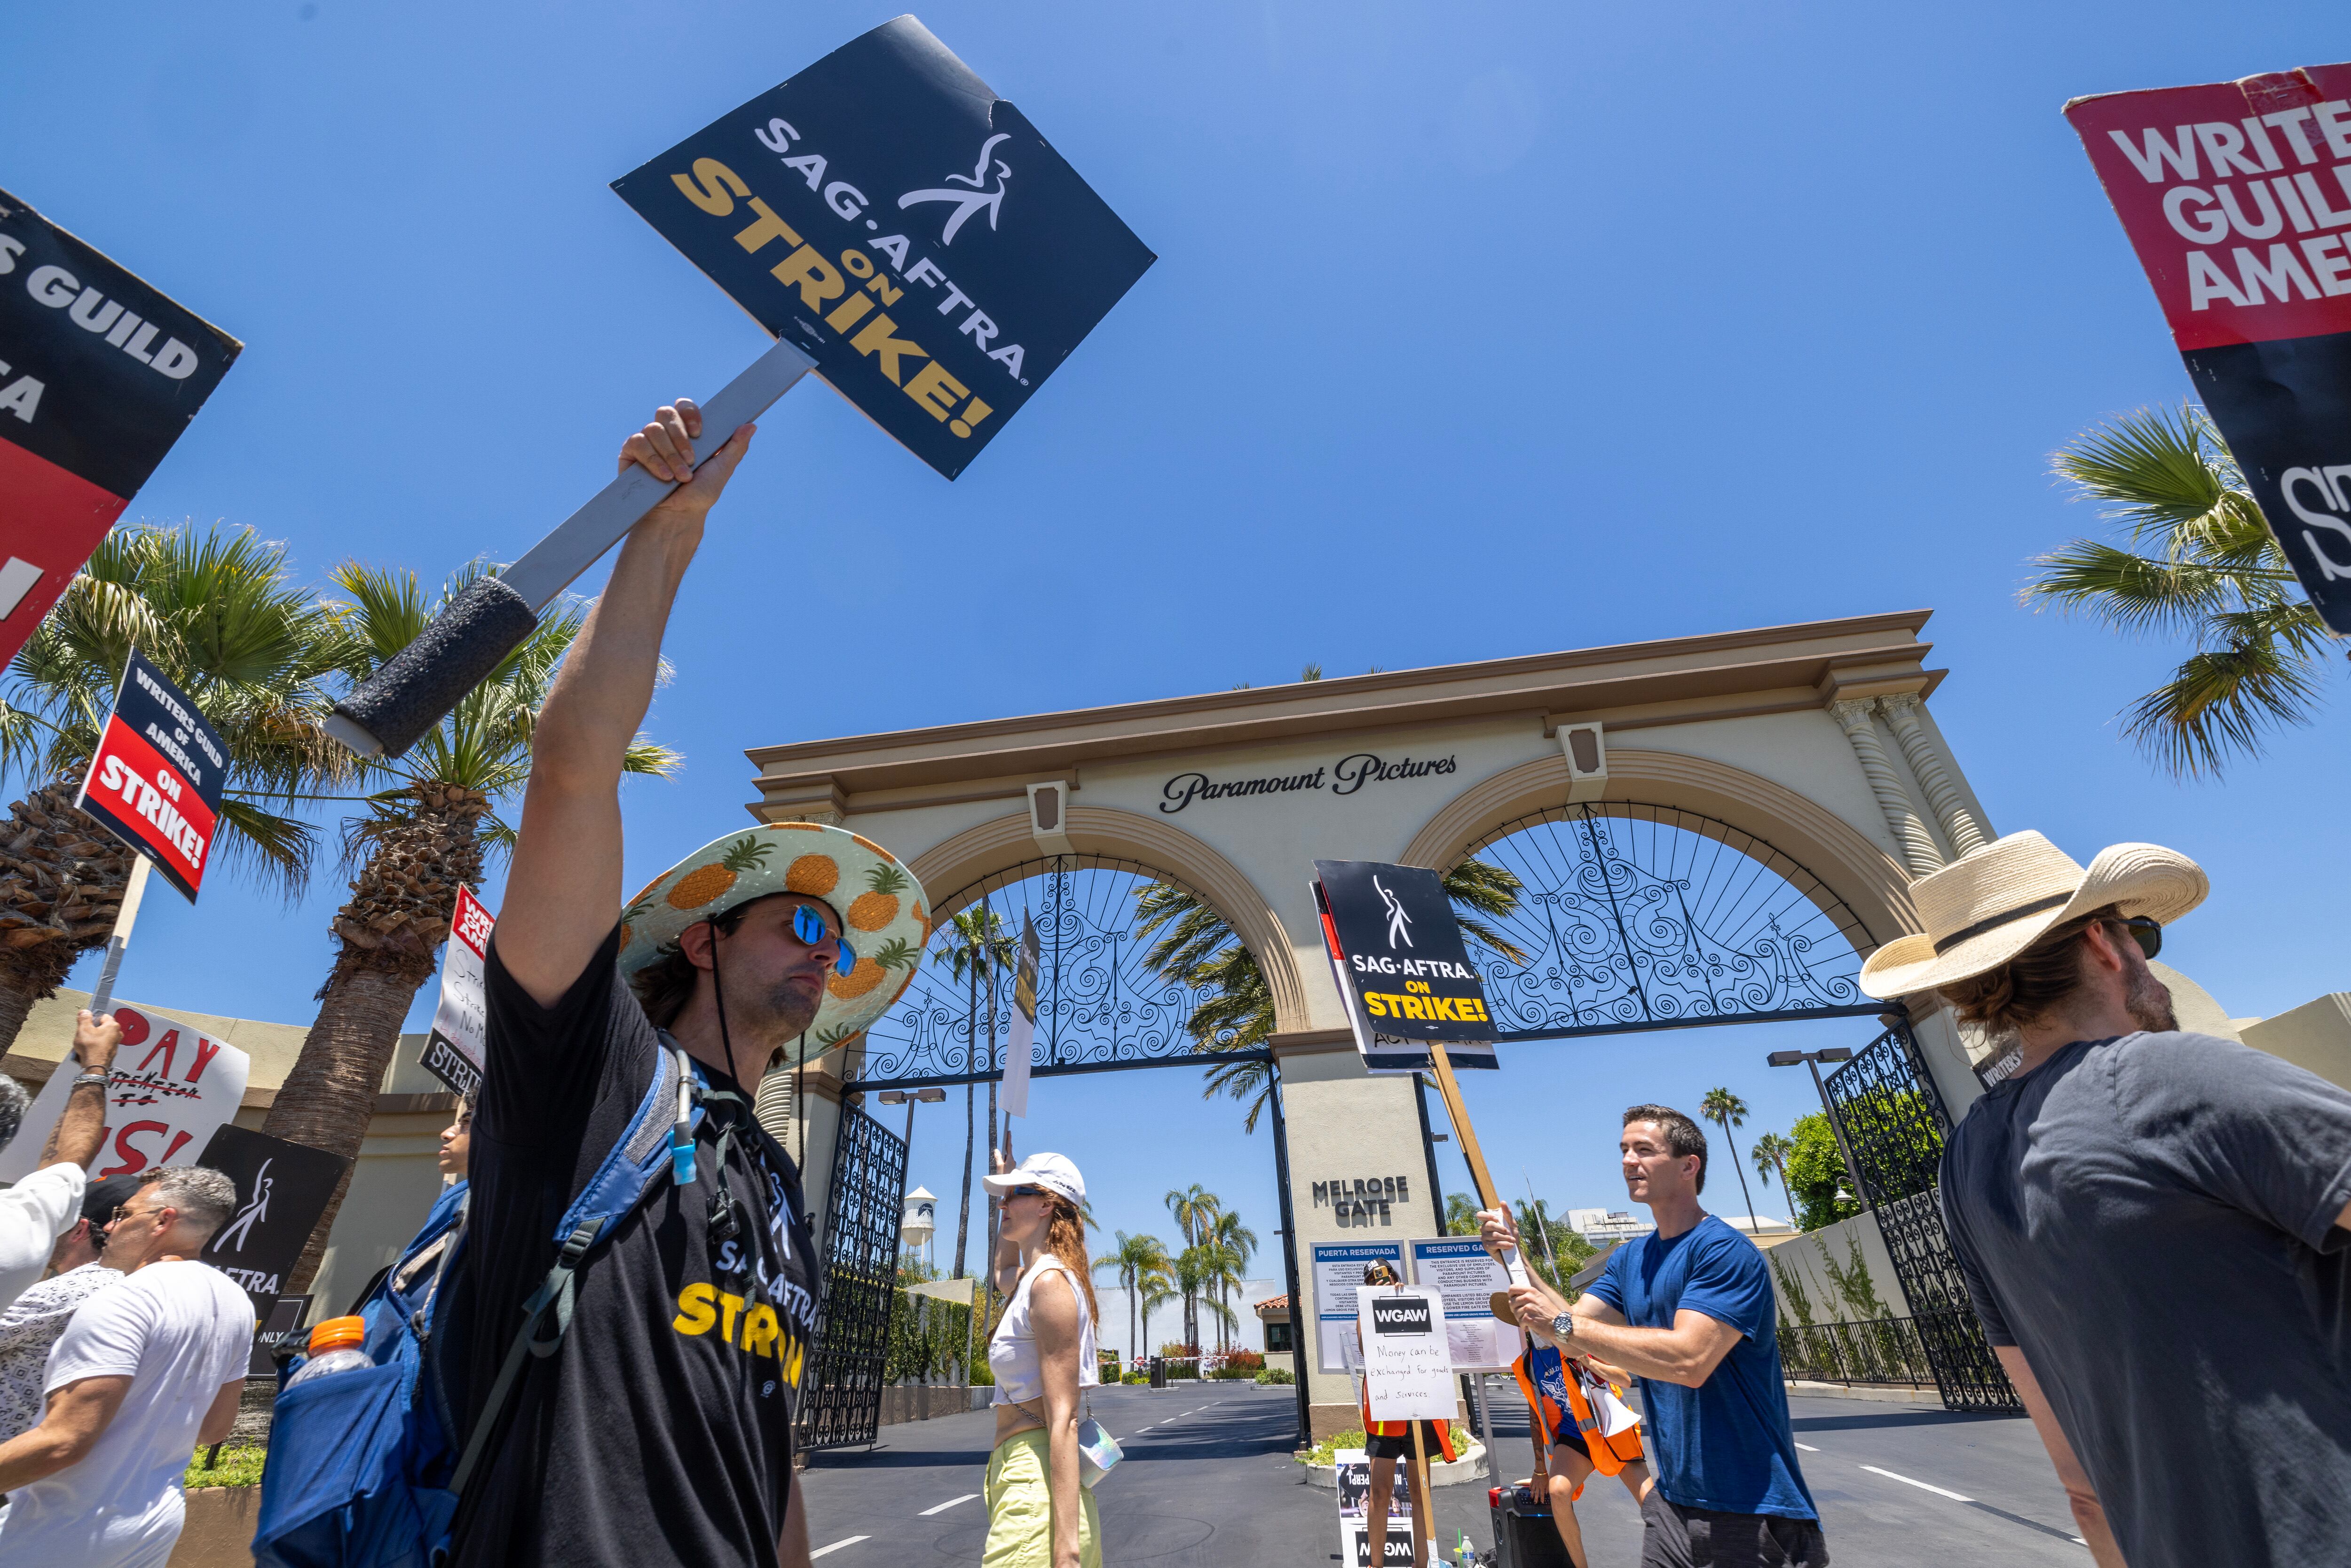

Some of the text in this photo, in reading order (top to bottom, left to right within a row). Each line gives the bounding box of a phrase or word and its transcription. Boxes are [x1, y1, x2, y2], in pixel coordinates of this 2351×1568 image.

[2108, 99, 2351, 183] WRITE
[2163, 165, 2351, 244] GUIL
[841, 249, 904, 307] ON
[2186, 232, 2351, 311] AME
[670, 157, 994, 438] STRIKE!
[27, 265, 198, 379] GUILD
[136, 667, 223, 768] WRITERS GUILD
[145, 722, 201, 786] AMERICA
[174, 727, 189, 746] OF
[157, 769, 181, 803] ON
[1160, 754, 1456, 813] Paramount Pictures
[99, 755, 205, 869] STRIKE!
[465, 896, 494, 933] WRI
[1405, 980, 1431, 993] ON
[1364, 992, 1488, 1022] STRIKE!
[113, 1008, 221, 1083] PAY
[1982, 1051, 2022, 1087] WRITERS
[1312, 1176, 1408, 1198] MELROSE
[1335, 1198, 1390, 1217] GATE
[1375, 1309, 1428, 1323] WGAW
[258, 1332, 284, 1343] NLY
[1377, 1345, 1406, 1363] Money
[1430, 1345, 1440, 1356] be
[1371, 1364, 1449, 1381] exchanged for goods
[1375, 1389, 1388, 1401] and
[1359, 1543, 1412, 1556] WGW
